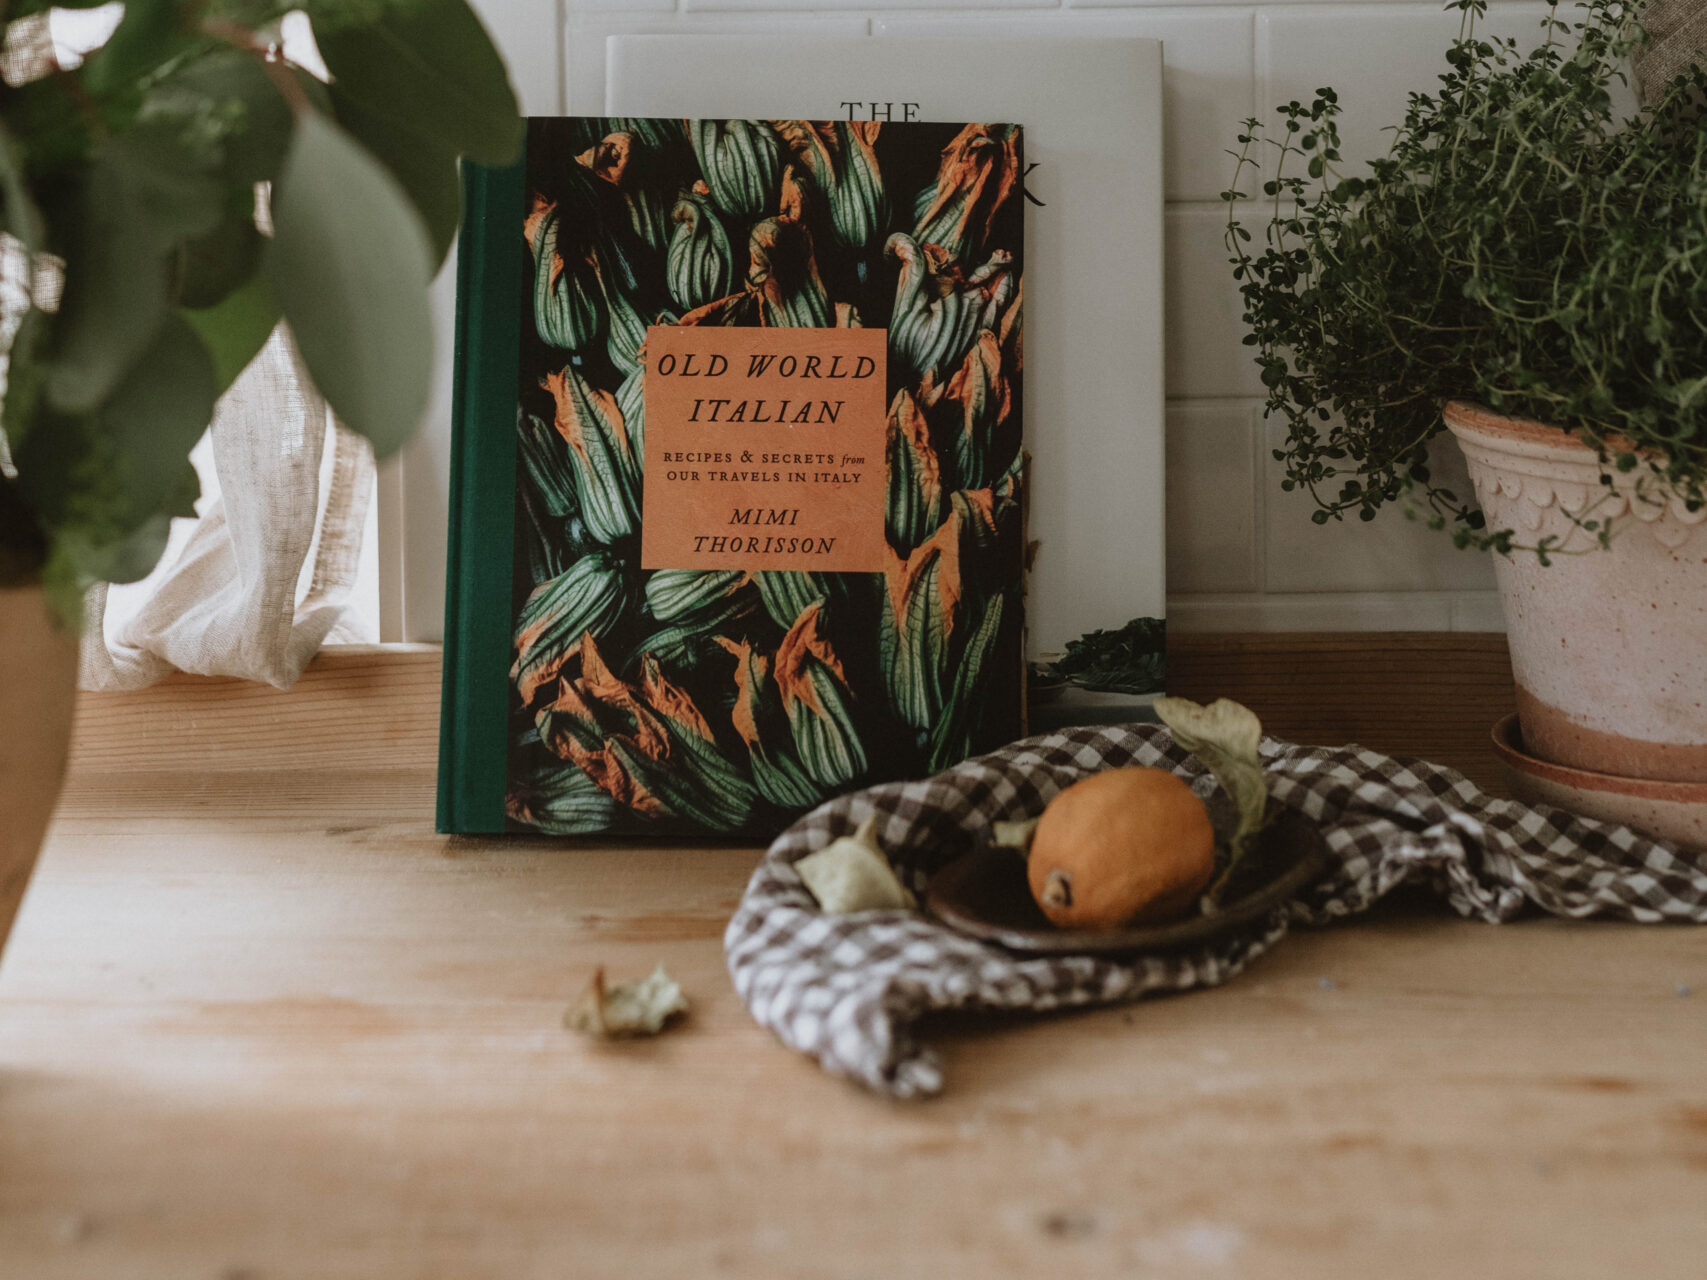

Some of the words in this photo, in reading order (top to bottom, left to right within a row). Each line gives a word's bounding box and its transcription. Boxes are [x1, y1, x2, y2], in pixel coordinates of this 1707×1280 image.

[840, 102, 921, 122] THE
[658, 354, 729, 377] OLD
[747, 355, 876, 379] WORLD
[688, 399, 845, 424] ITALIAN
[664, 452, 732, 463] RECIPES
[740, 450, 753, 463] &
[762, 453, 835, 464] SECRETS
[840, 454, 865, 467] from
[667, 471, 700, 481] OUR
[708, 471, 780, 482] TRAVELS
[788, 472, 806, 483] IN
[814, 473, 862, 483] ITALY
[728, 508, 800, 526] MIMI
[693, 536, 836, 554] THORISSON
